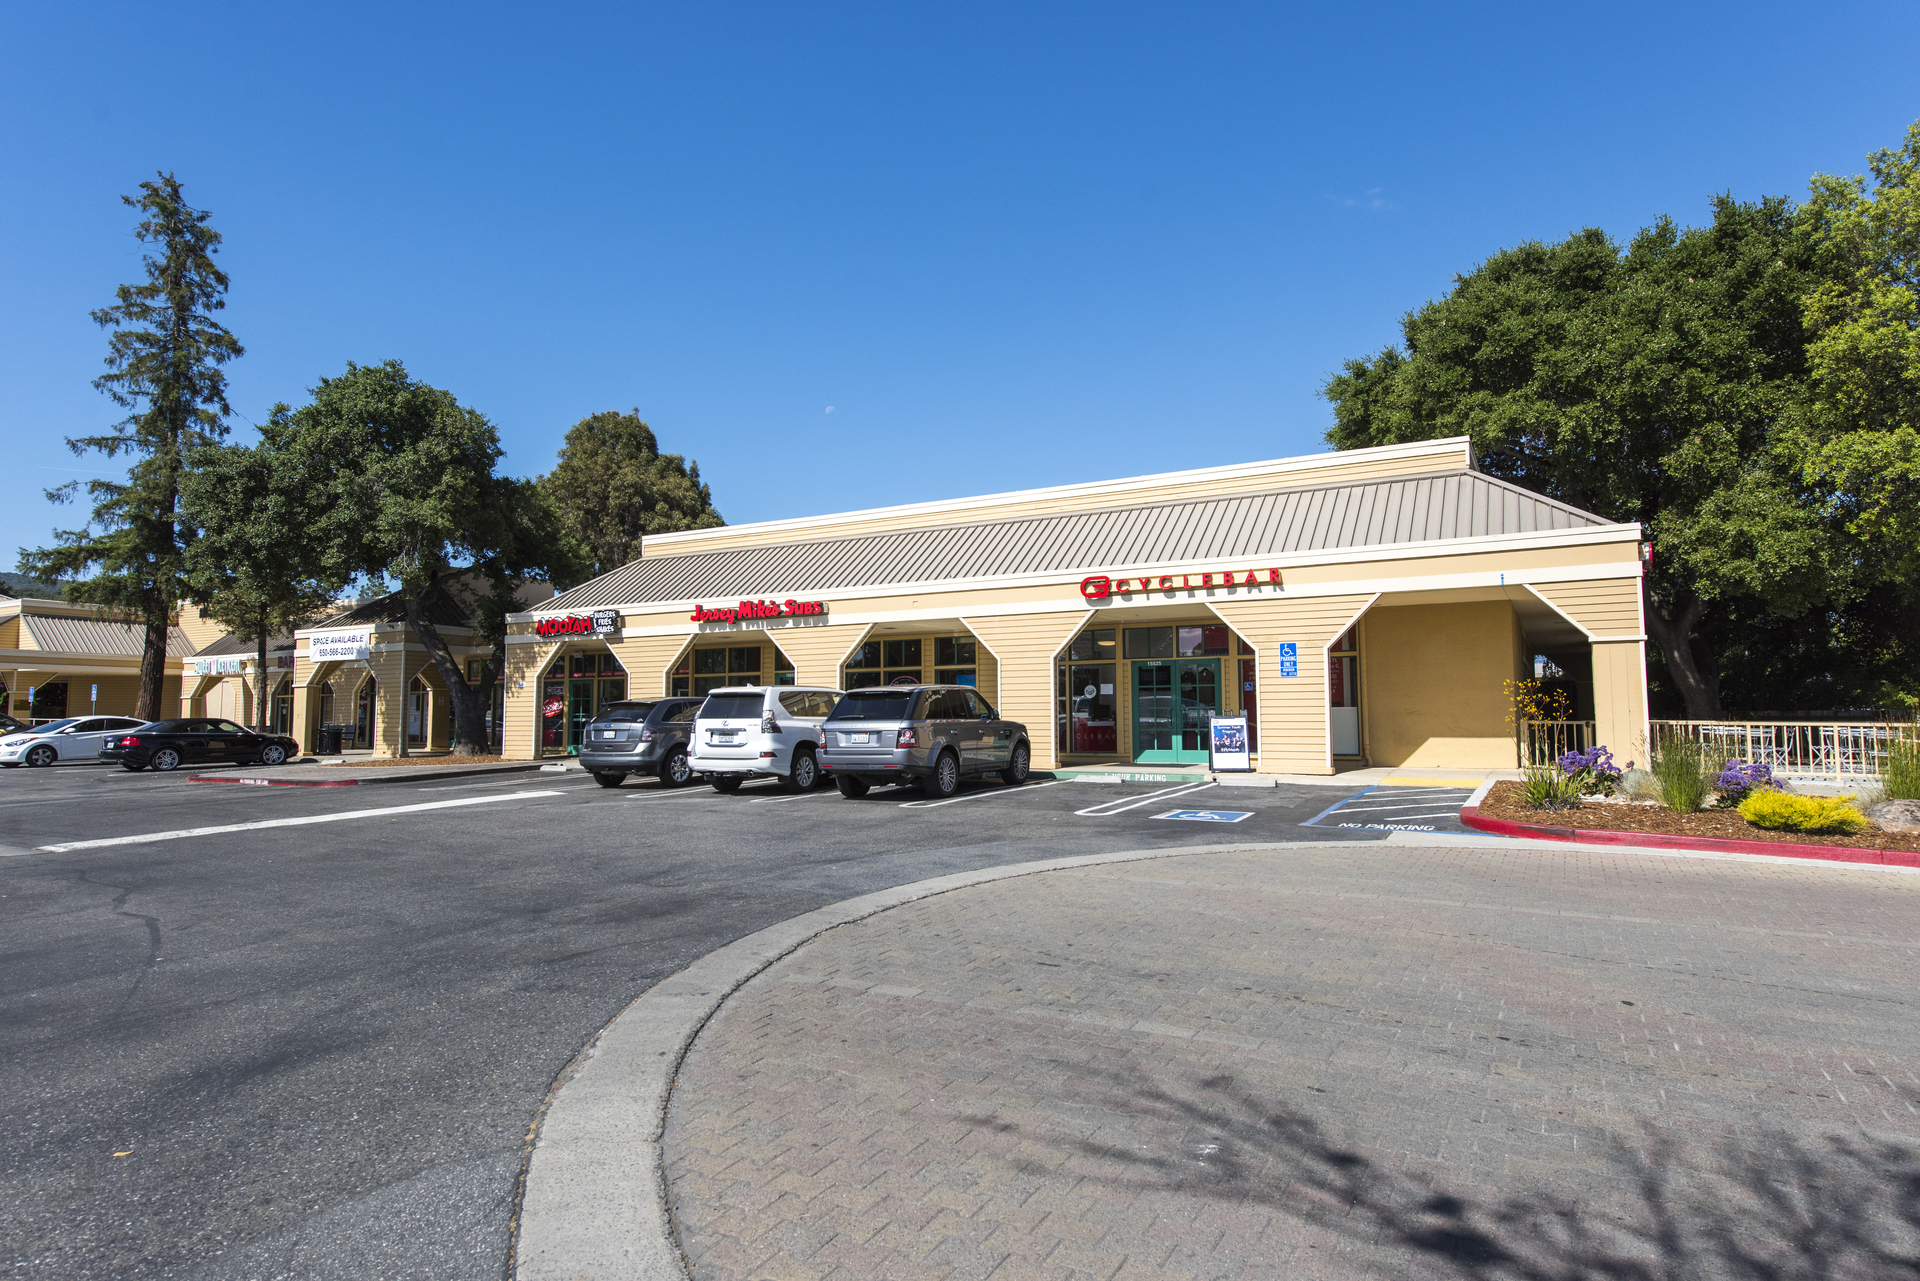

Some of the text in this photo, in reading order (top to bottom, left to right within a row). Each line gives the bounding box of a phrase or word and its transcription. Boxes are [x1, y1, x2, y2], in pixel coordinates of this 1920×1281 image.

[1116, 568, 1281, 593] CYCLEBAR
[594, 610, 616, 619] BURGERS
[690, 604, 736, 625] Jersey
[737, 599, 781, 619] Mike's
[597, 618, 612, 626] FRIES
[312, 634, 364, 647] SPACE AVAILABLE
[319, 647, 355, 657] 650-566-2200
[1135, 773, 1167, 782] PARKING
[1365, 823, 1436, 831] PARKING
